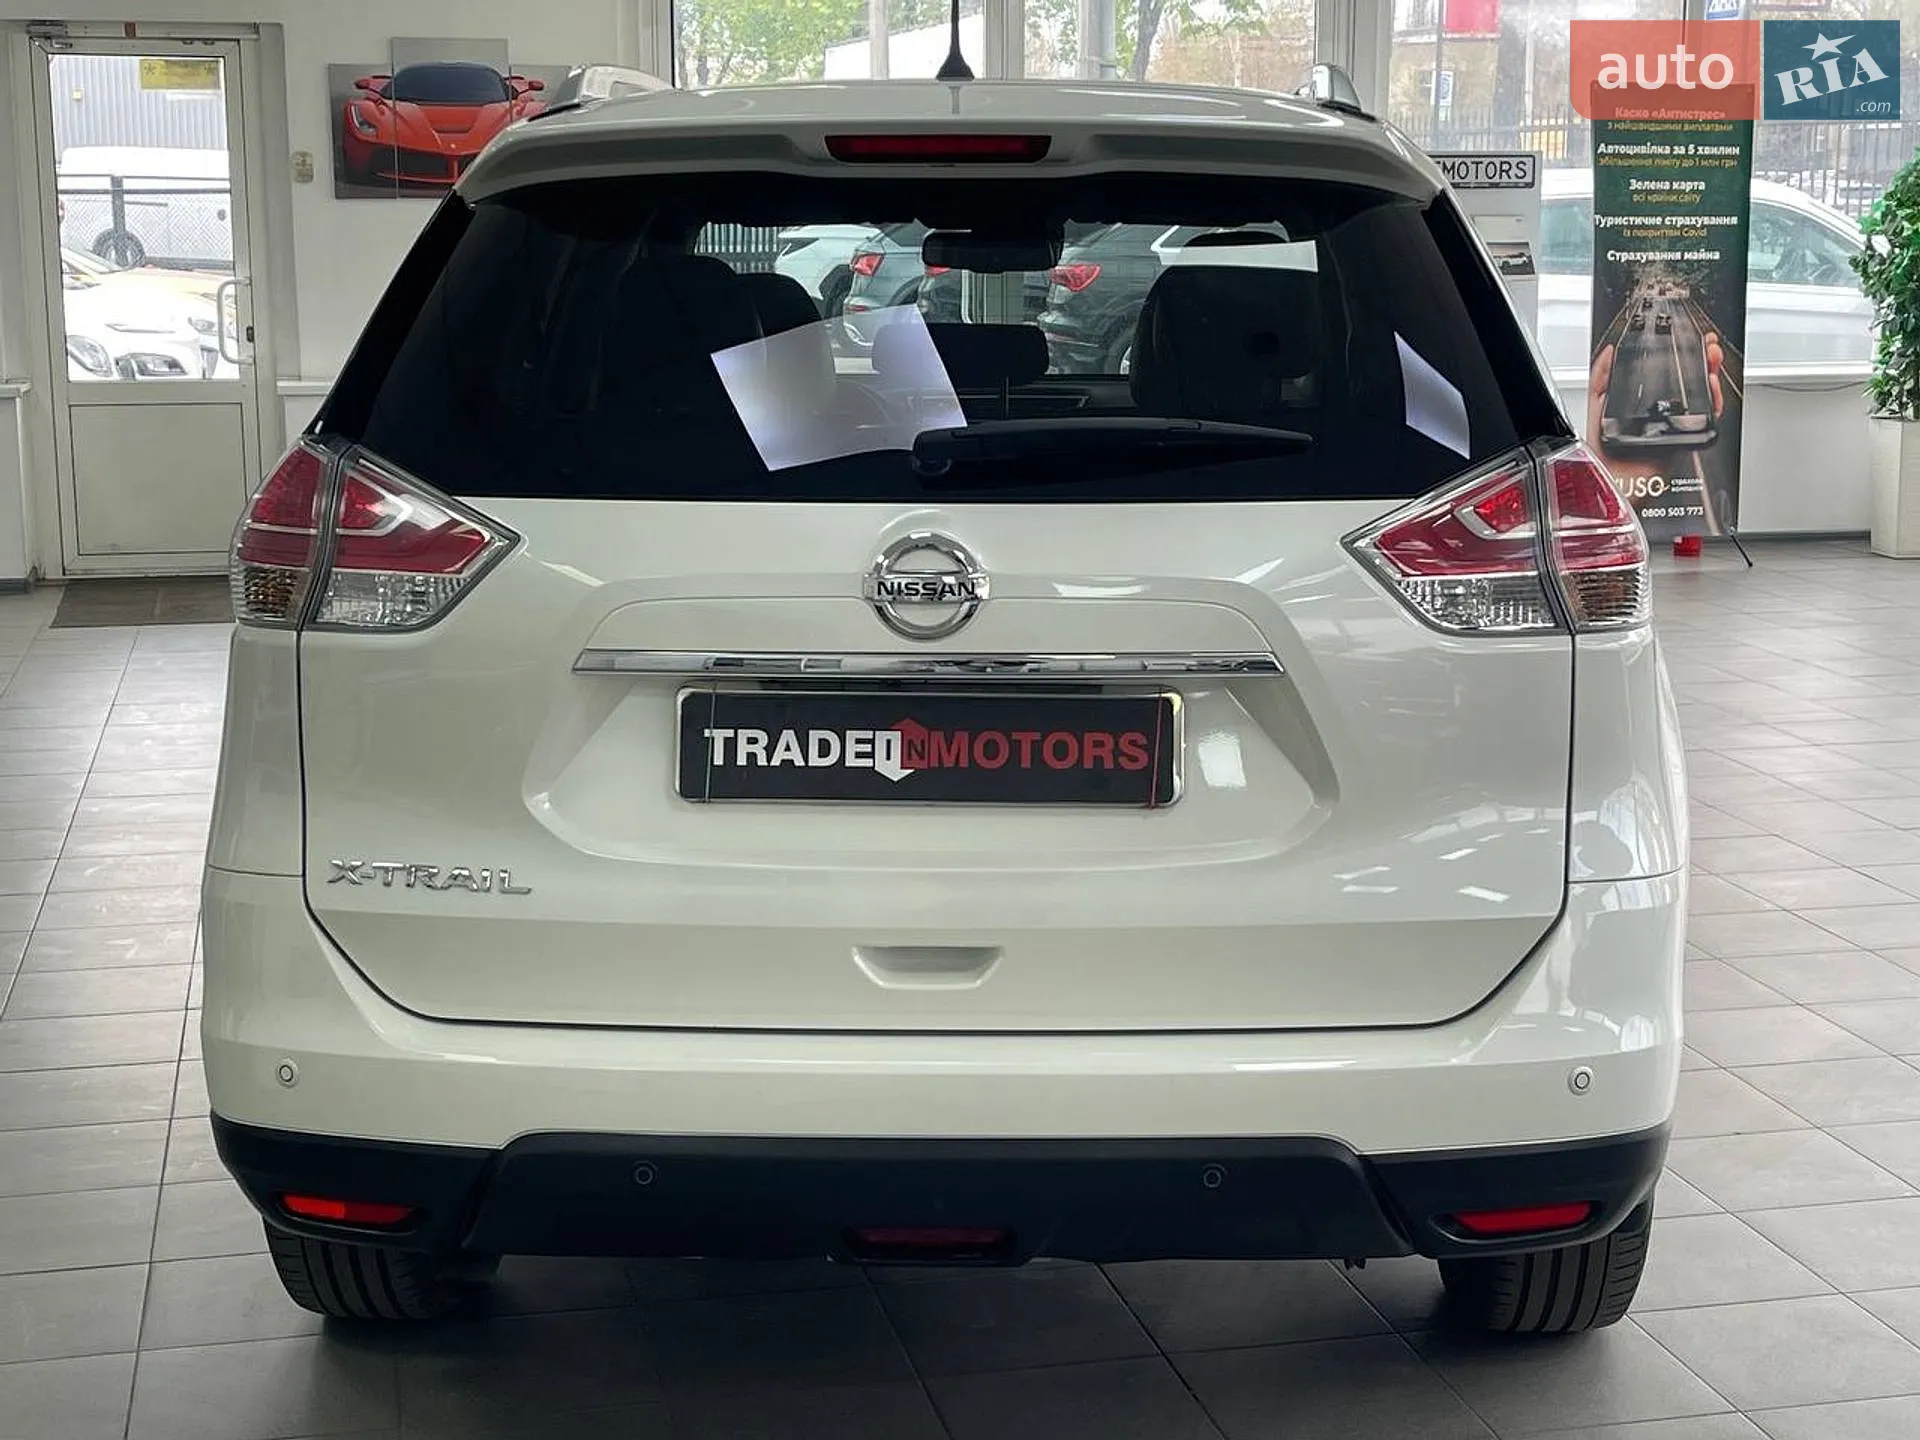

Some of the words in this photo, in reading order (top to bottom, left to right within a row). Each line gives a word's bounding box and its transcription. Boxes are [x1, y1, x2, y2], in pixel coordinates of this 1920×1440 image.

[1615, 107, 1649, 119] Каско
[1597, 142, 1671, 156] Автоцивілка
[1672, 146, 1685, 155] за
[1687, 144, 1696, 155] 5
[1697, 146, 1740, 156] хвилин
[1434, 161, 1527, 180] MOTORS
[1629, 179, 1670, 190] Зелена
[1672, 181, 1705, 192] карта
[1594, 215, 1662, 227] Туристичне
[1664, 215, 1738, 227] страхування
[1607, 250, 1681, 263] Страхування
[1683, 248, 1721, 261] майна
[1642, 507, 1666, 518] 0800
[1668, 507, 1685, 517] 503
[1686, 506, 1704, 516] 773
[877, 580, 975, 597] NISSAN
[327, 859, 532, 895] X-TRAIL
